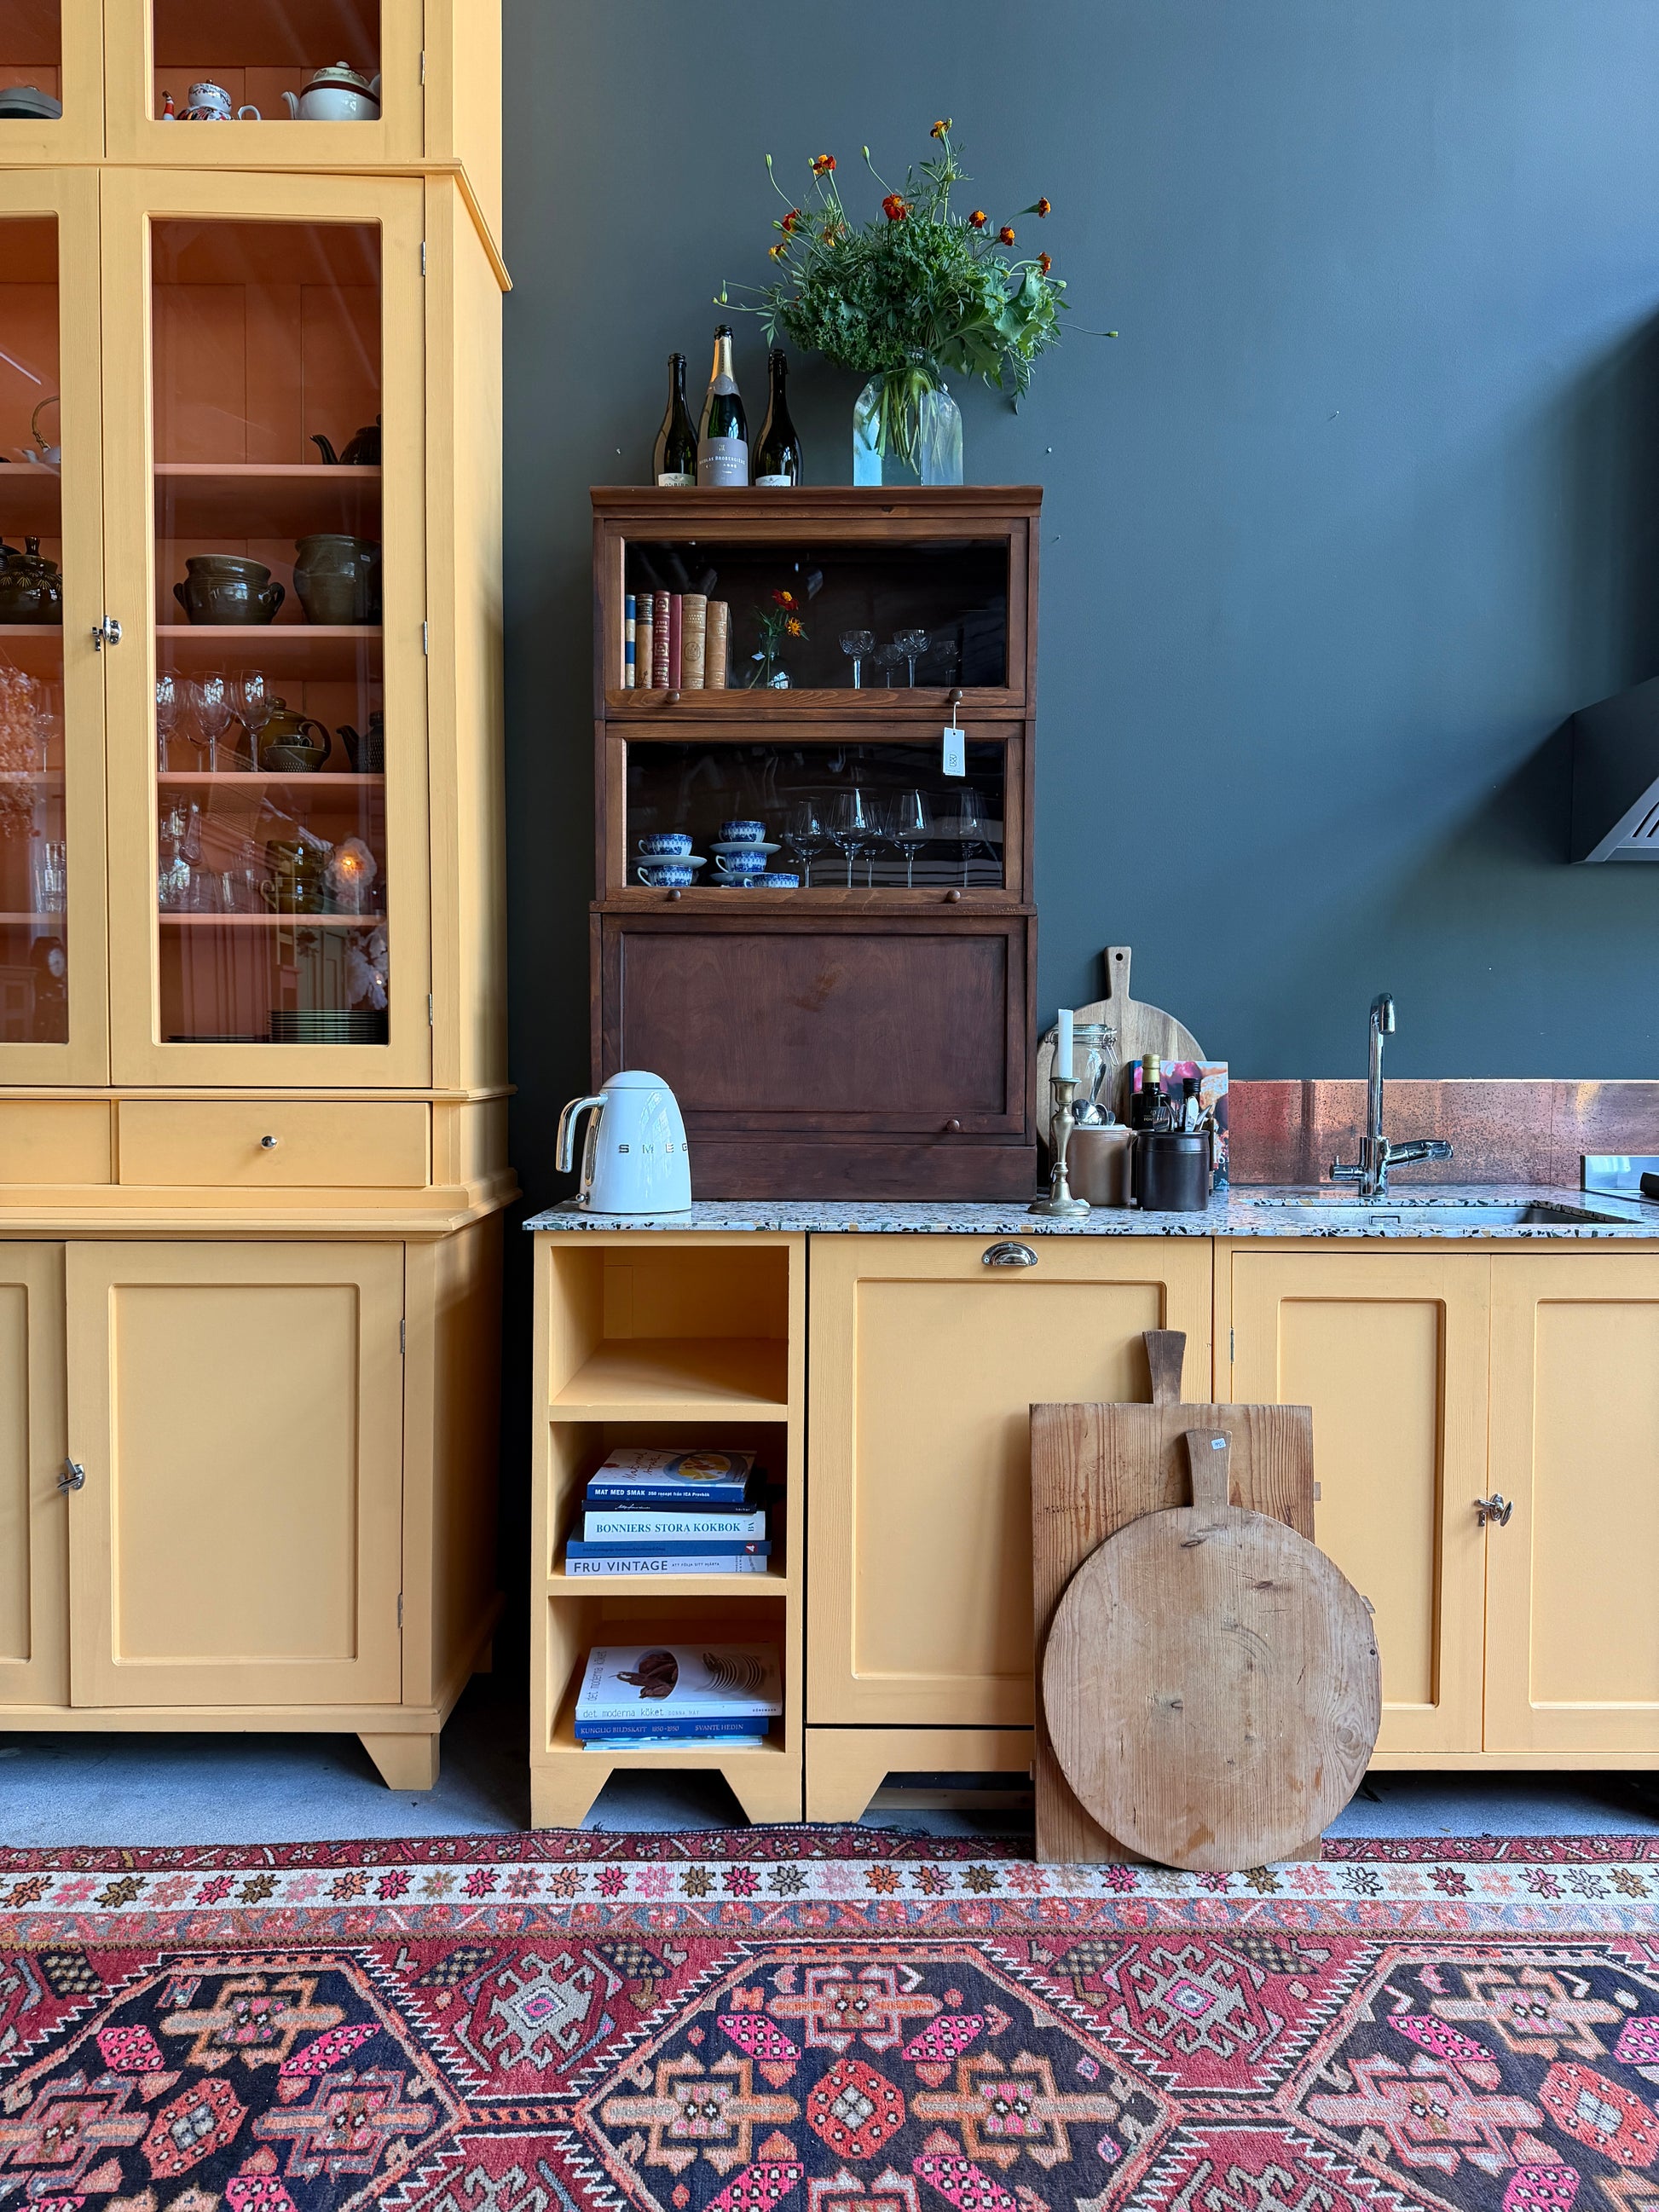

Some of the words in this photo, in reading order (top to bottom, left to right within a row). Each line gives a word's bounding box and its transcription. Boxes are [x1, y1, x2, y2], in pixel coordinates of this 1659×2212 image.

[619, 1142, 688, 1153] SMEG
[596, 1523, 651, 1533] BONNIERS
[655, 1523, 691, 1532] STORA
[693, 1522, 741, 1532] KOKBOK
[574, 1562, 601, 1573] FRU
[606, 1560, 668, 1572] VINTAGE
[602, 1709, 636, 1718] moderna
[641, 1708, 664, 1717] köket
[581, 1726, 612, 1735] KUNGLIG
